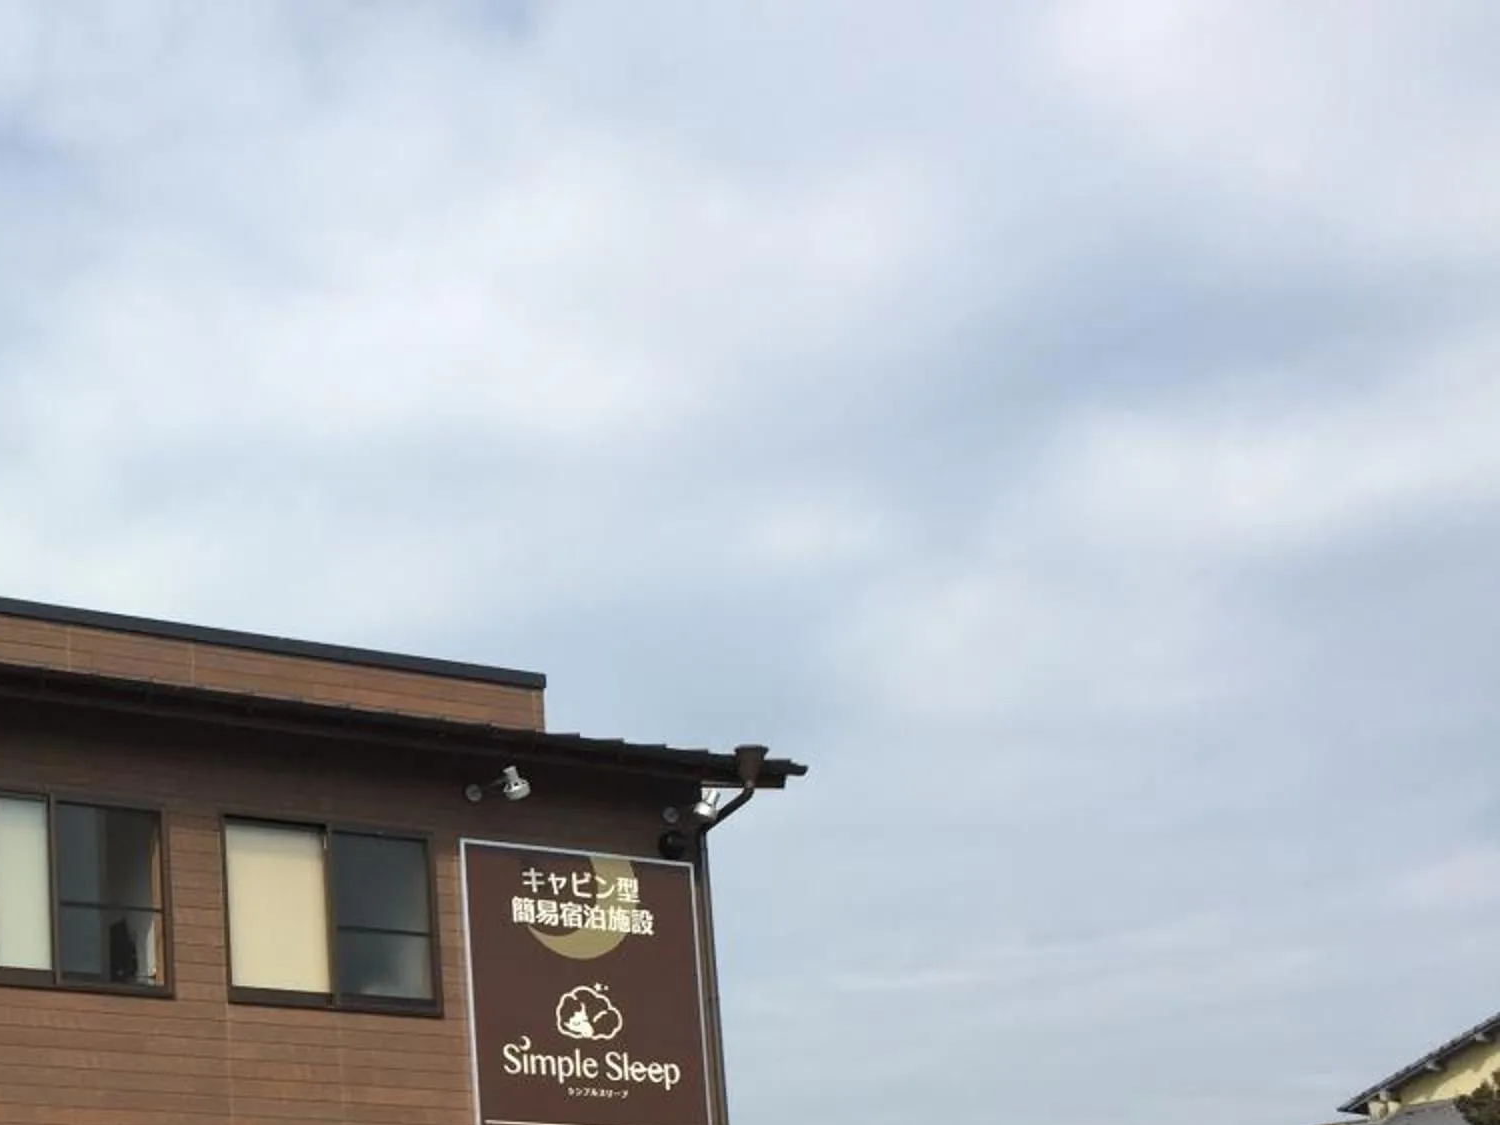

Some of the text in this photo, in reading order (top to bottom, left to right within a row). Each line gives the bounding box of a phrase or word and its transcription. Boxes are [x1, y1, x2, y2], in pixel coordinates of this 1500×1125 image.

[522, 867, 640, 903] キャビン型
[511, 896, 654, 936] 簡易宿泊施設
[503, 1035, 681, 1091] Simple Sleep
